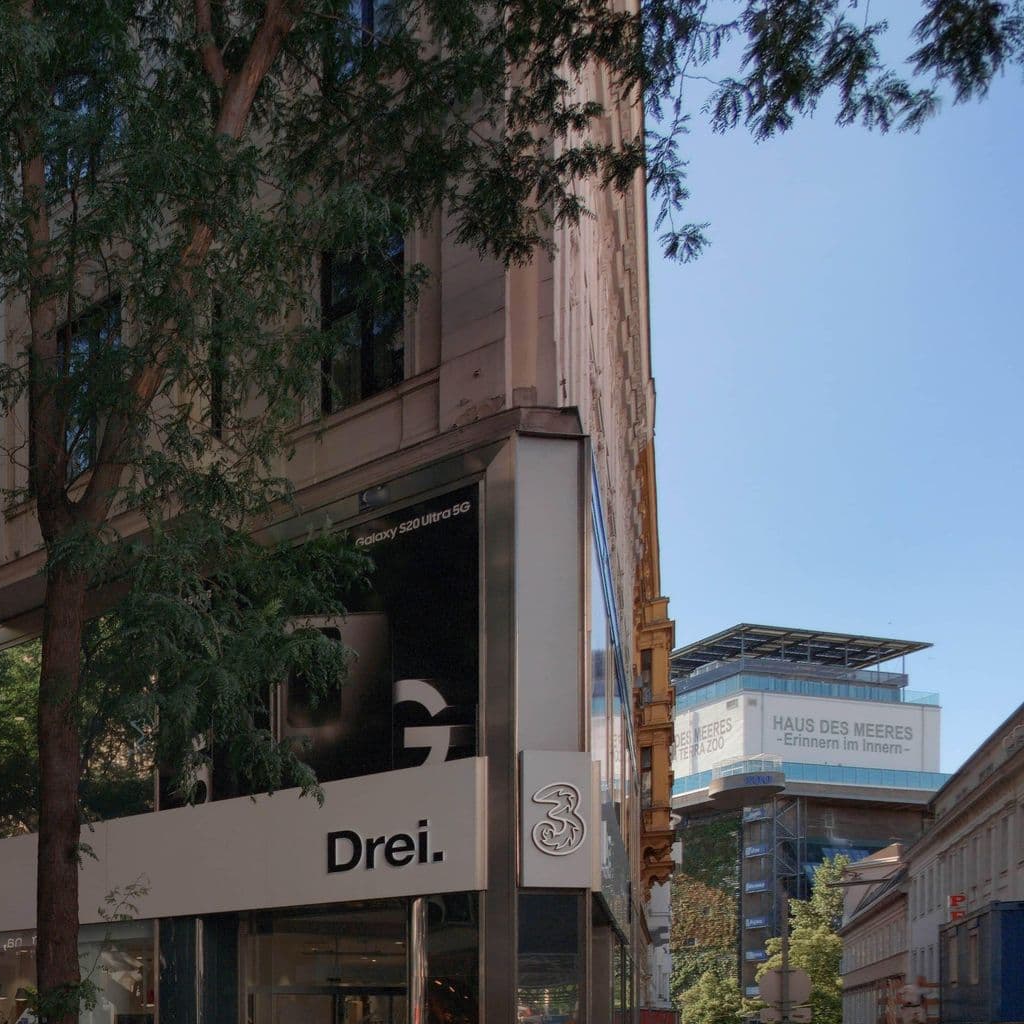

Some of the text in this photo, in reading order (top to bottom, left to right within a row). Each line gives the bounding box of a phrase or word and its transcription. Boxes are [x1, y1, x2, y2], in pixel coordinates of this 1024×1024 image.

[355, 501, 472, 547] Galaxy S20 Ultra 5G
[694, 717, 733, 743] MEERES
[772, 715, 913, 741] HAUS DES MEERES
[843, 736, 859, 751] im
[326, 819, 444, 875] Drei.
